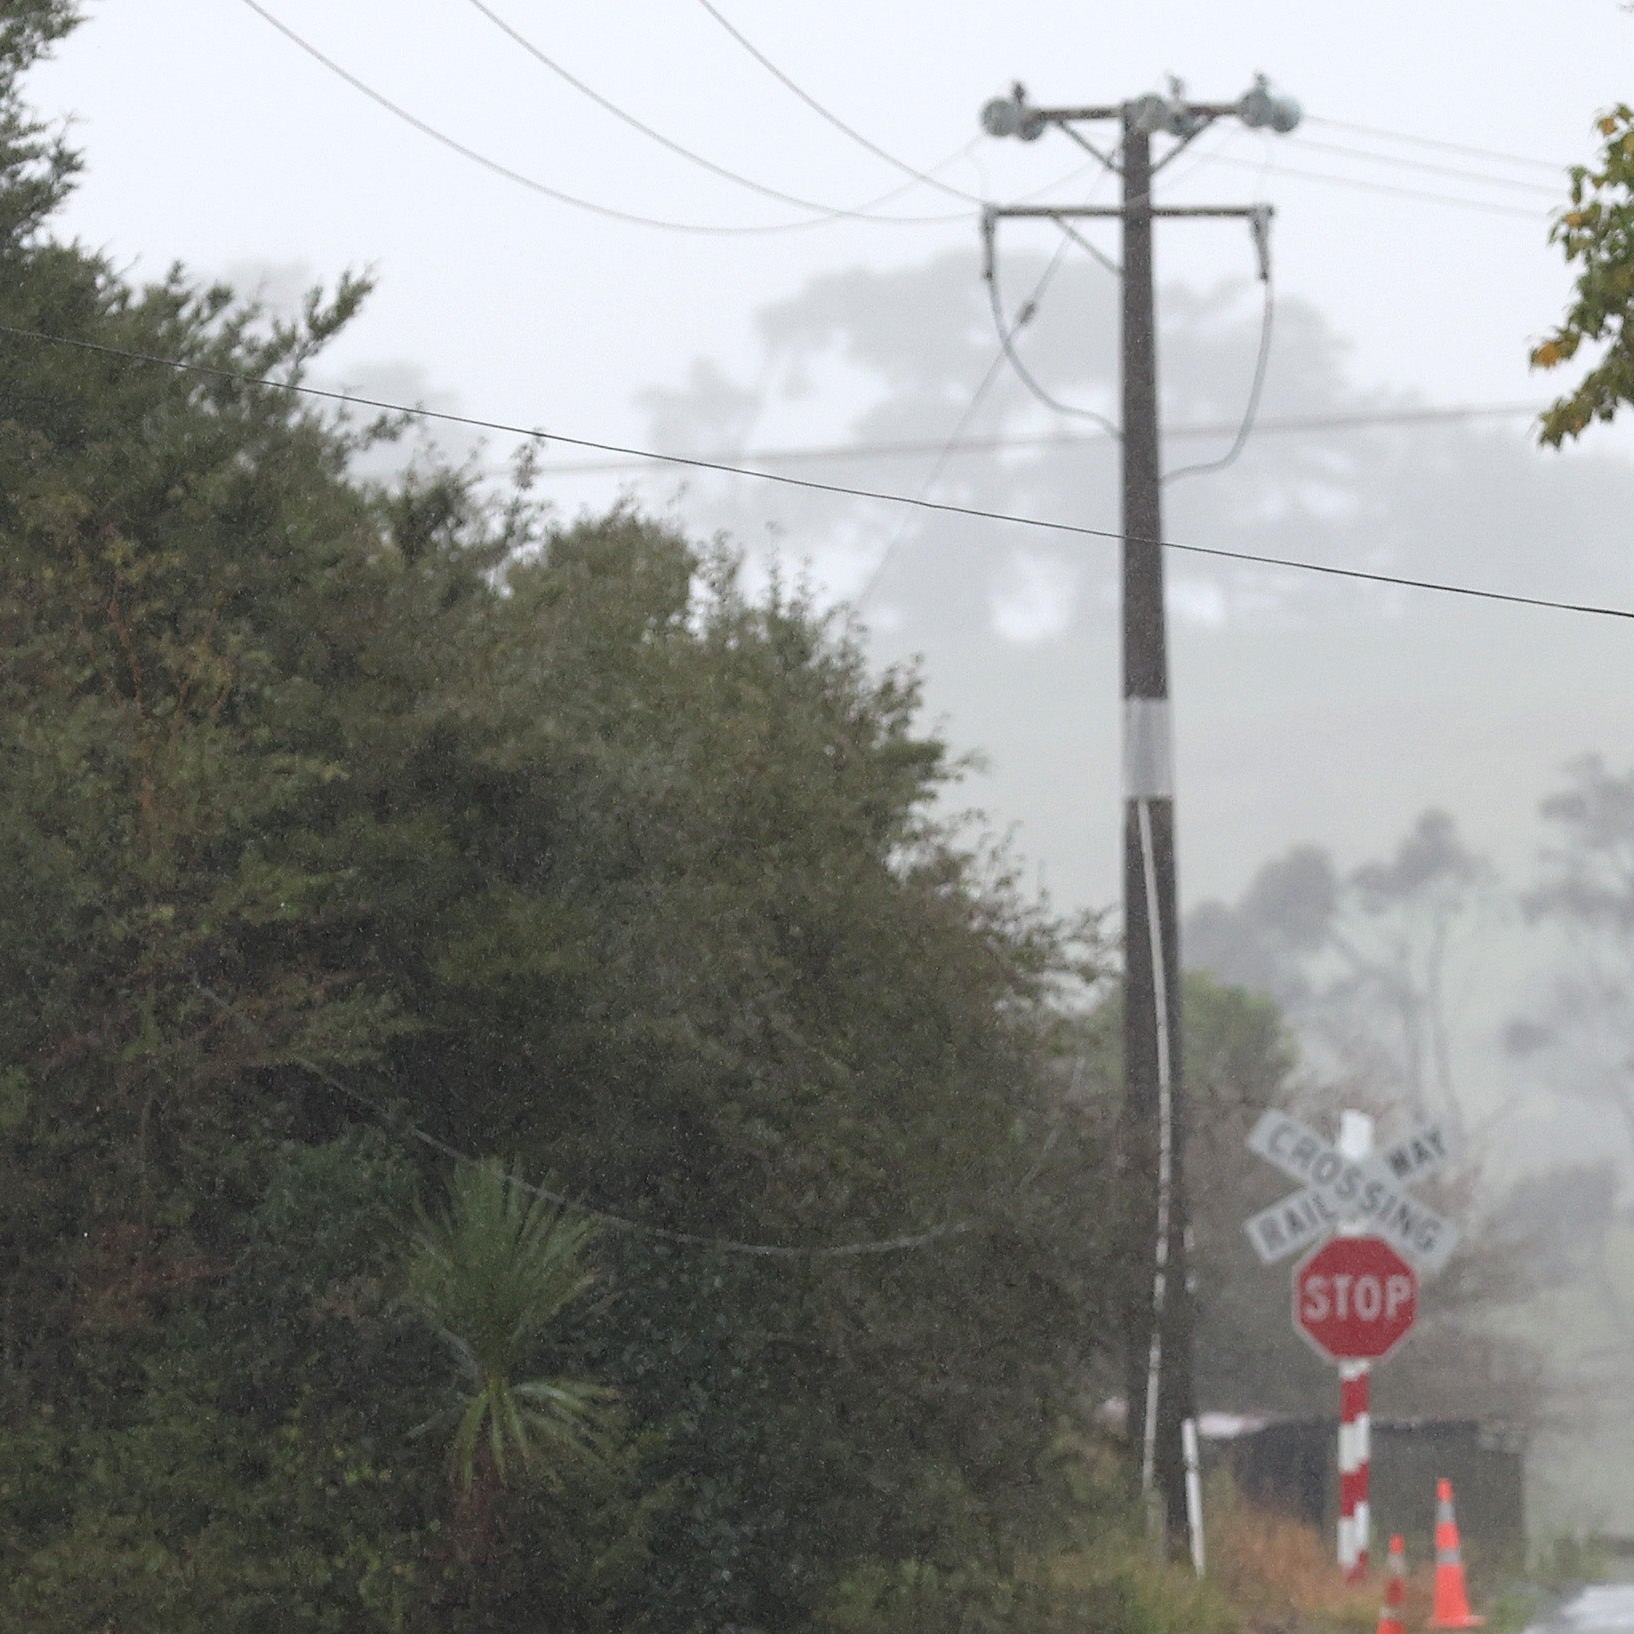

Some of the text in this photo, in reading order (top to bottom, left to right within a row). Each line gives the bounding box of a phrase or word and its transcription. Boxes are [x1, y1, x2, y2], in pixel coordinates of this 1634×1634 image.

[1258, 1124, 1446, 1252] RAIL WAY
[1268, 1120, 1443, 1253] CROSSING
[1303, 1273, 1412, 1322] STOP
